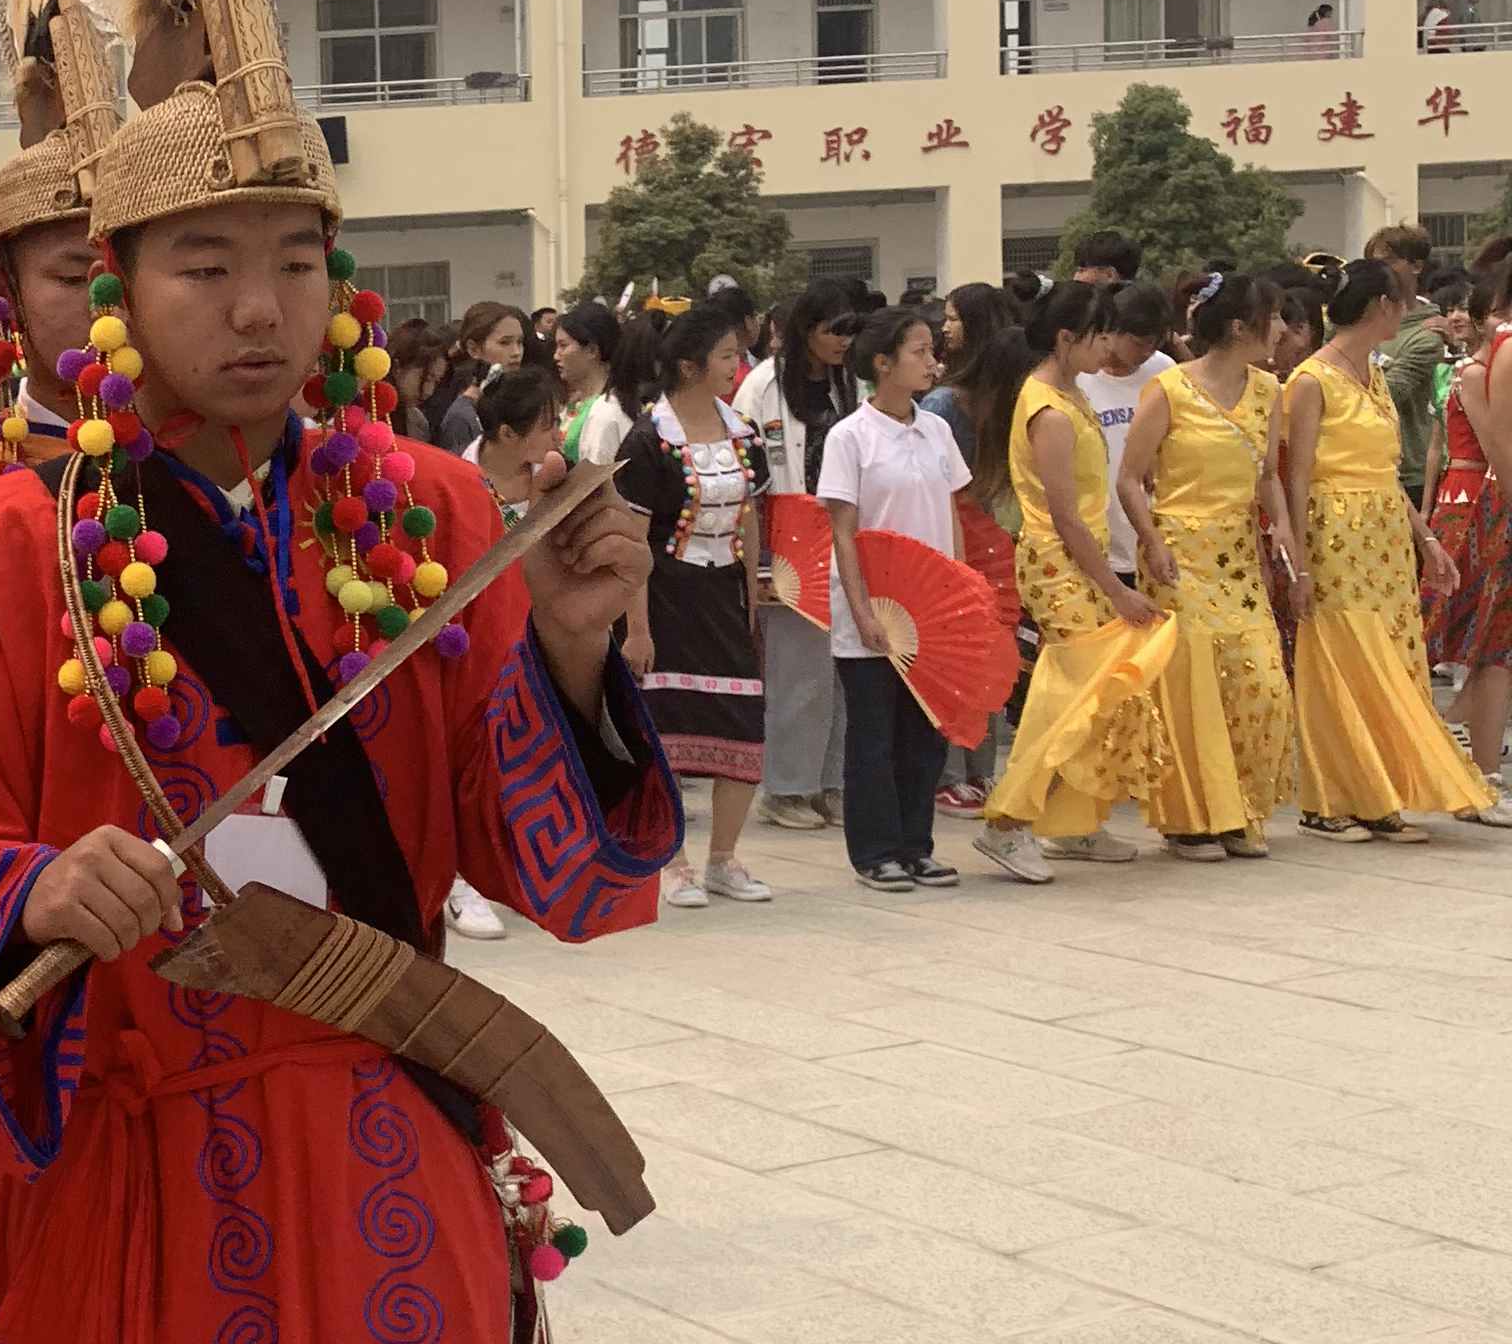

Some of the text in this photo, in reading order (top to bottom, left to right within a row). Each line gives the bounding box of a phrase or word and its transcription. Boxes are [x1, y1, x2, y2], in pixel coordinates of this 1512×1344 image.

[615, 85, 1469, 176] 德宏职业学福建华
